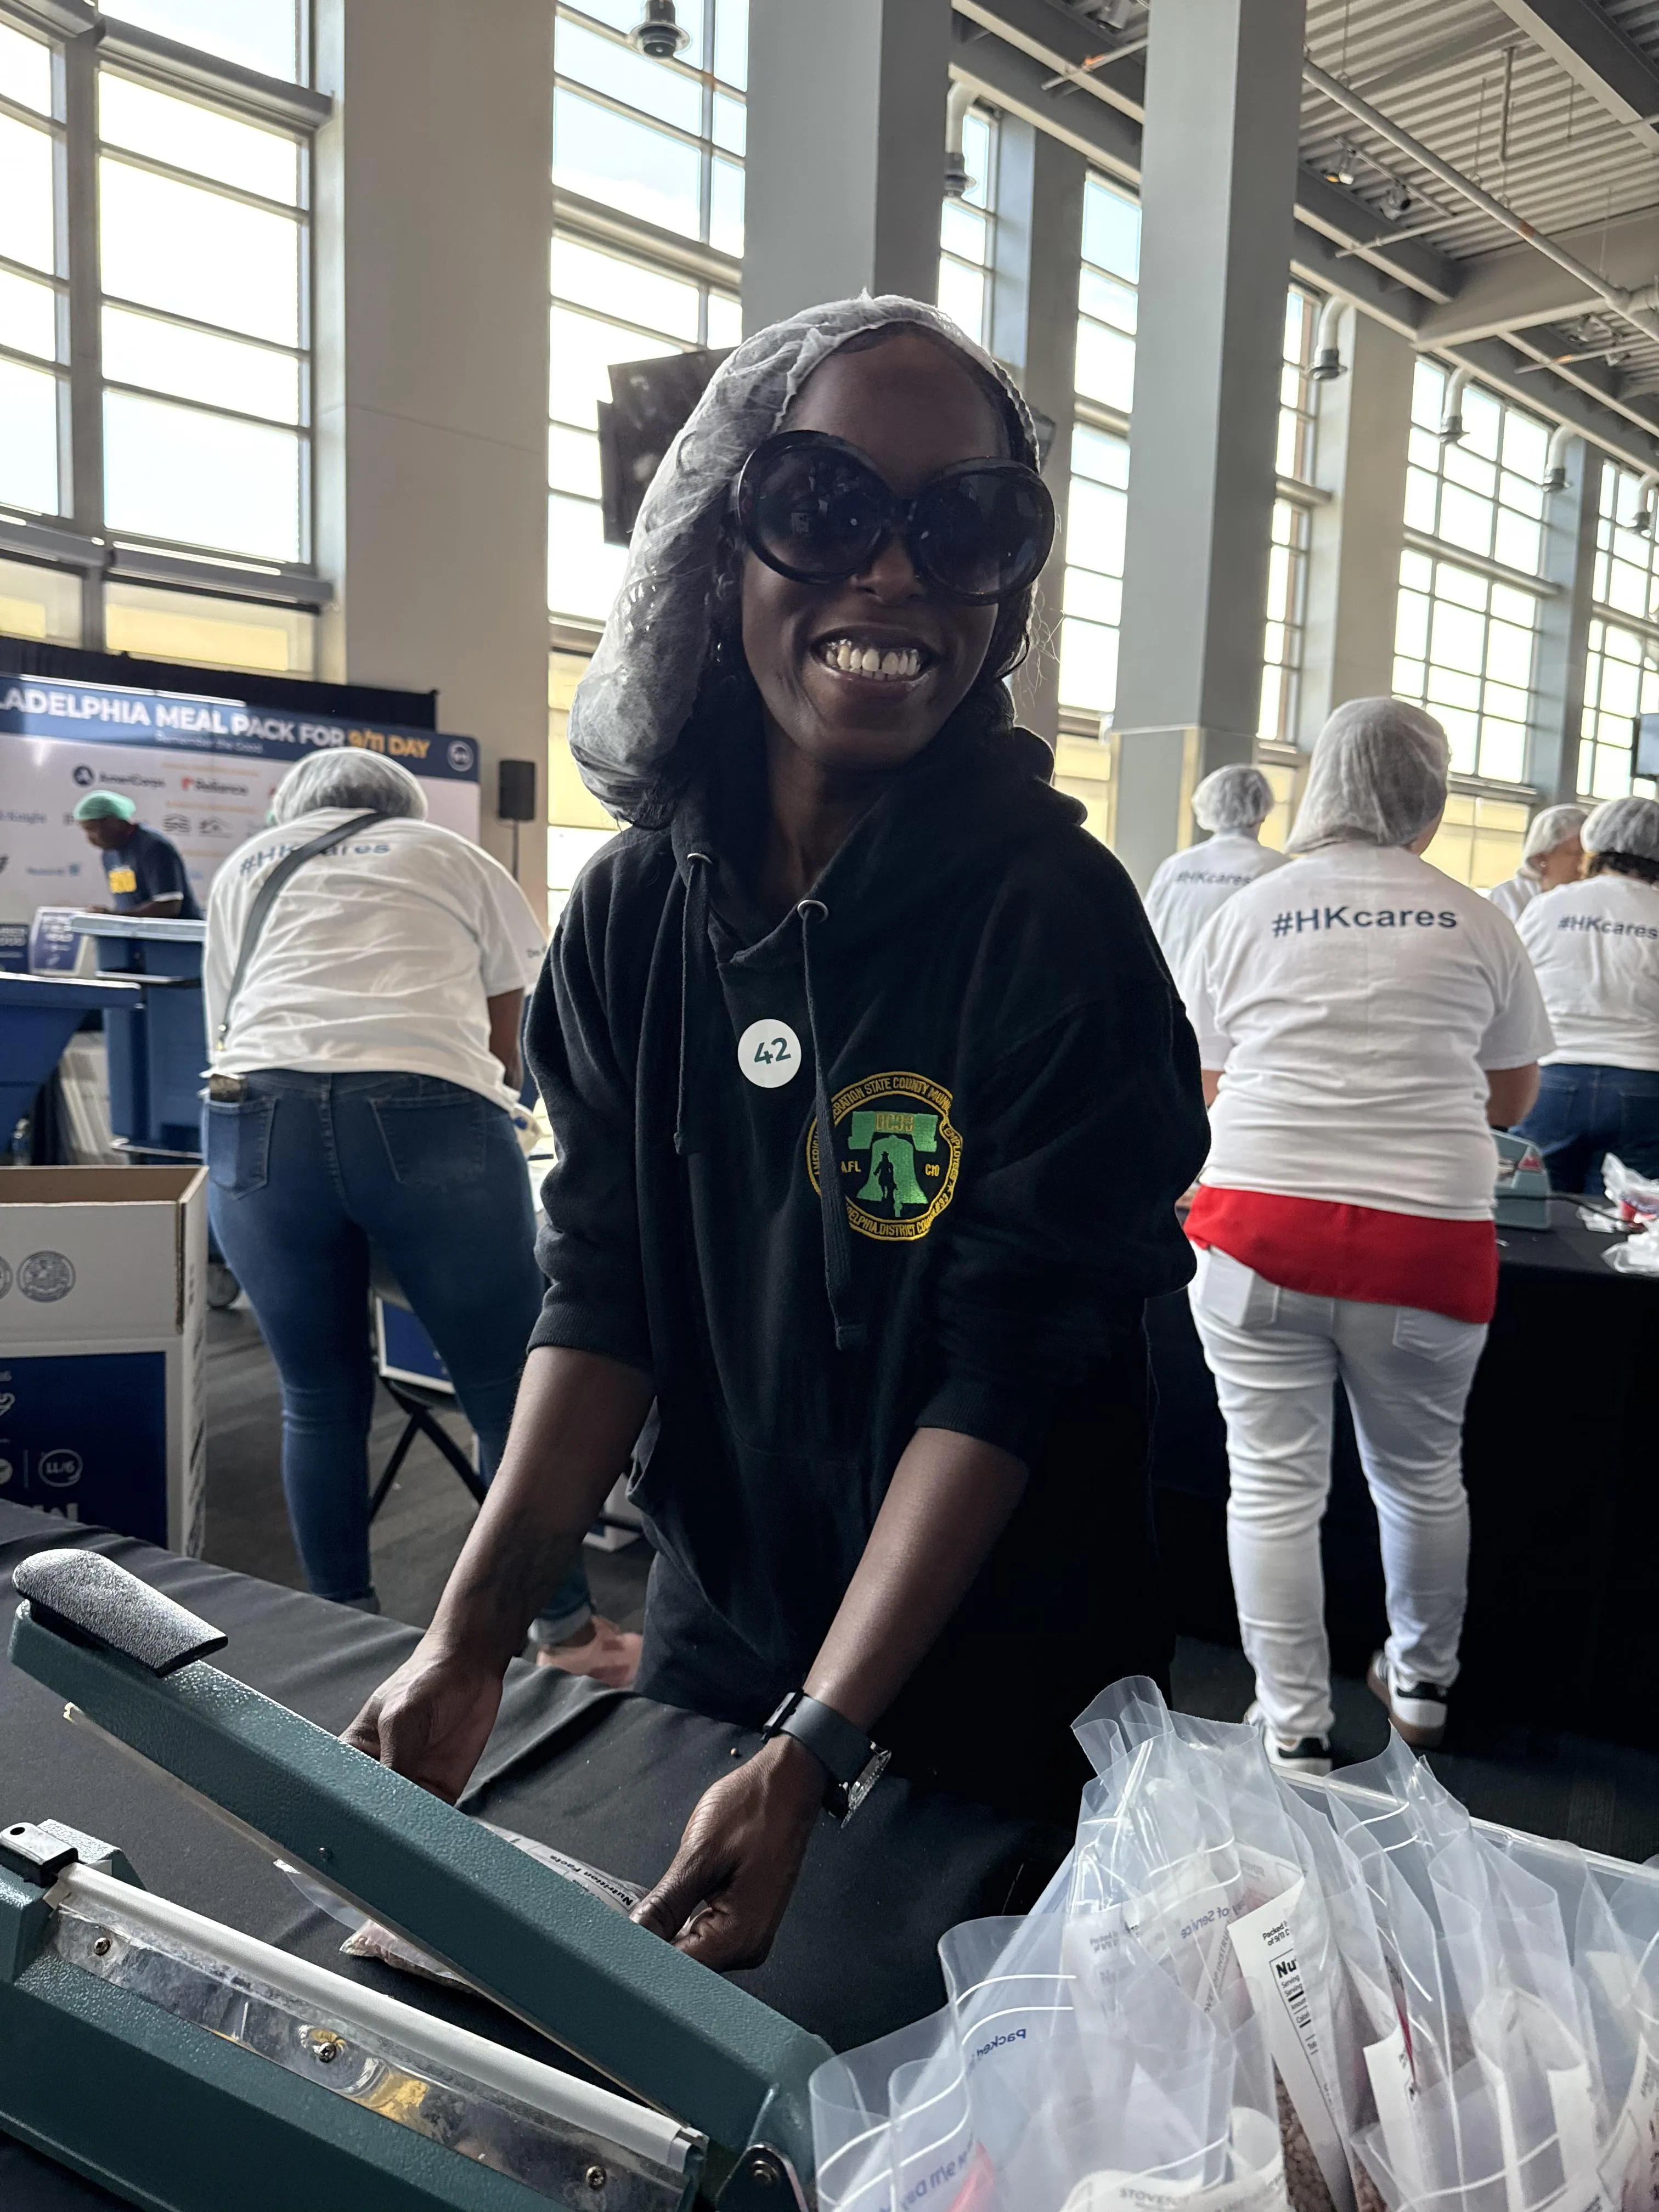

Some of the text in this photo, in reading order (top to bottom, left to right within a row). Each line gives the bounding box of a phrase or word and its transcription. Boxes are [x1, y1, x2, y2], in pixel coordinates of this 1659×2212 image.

[155, 703, 228, 734] MEAL
[230, 712, 296, 743] PACK
[298, 721, 346, 747] FOR
[348, 727, 386, 752] 9/11
[388, 734, 431, 759] DAY
[239, 843, 390, 876] #HKares
[1272, 905, 1458, 939] #HKcares
[1558, 915, 1658, 940] #HKcares
[754, 1037, 791, 1065] 42
[833, 1087, 865, 1117] ERATION
[865, 1077, 891, 1095] STATE
[893, 1077, 930, 1096] COUNTY
[943, 1127, 961, 1181] EMPLOYEES
[875, 1113, 915, 1132] DC33
[925, 1164, 940, 1177] CIO
[879, 1223, 916, 1237] DISTRICT
[550, 1854, 582, 1873] Facts
[584, 1871, 634, 1906] Nutrition
[1262, 1922, 1284, 1940] Packed
[1267, 1938, 1274, 1946] of
[1274, 1931, 1286, 1943] 9/11
[1282, 1974, 1300, 1989] Serving
[1284, 1983, 1303, 1997] Serving
